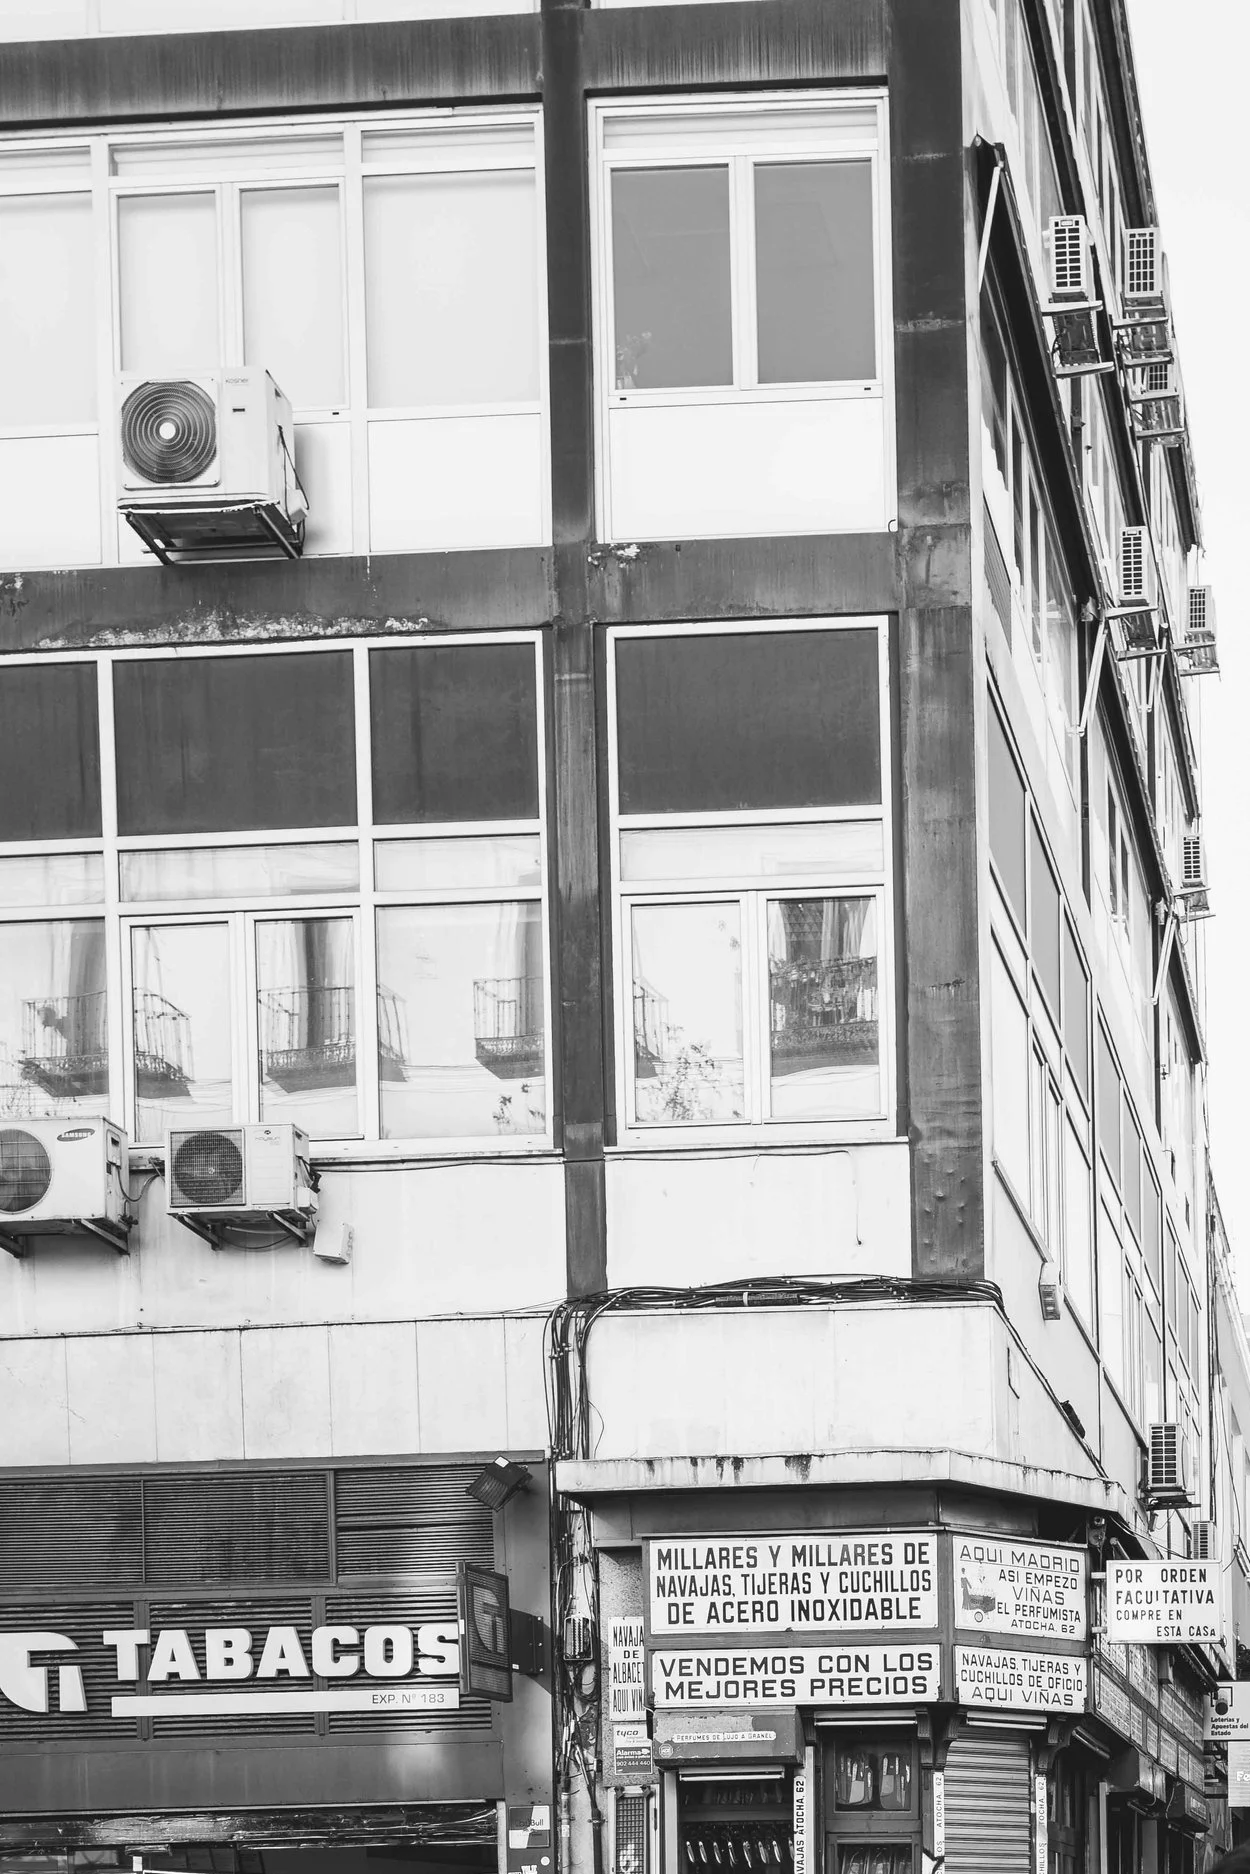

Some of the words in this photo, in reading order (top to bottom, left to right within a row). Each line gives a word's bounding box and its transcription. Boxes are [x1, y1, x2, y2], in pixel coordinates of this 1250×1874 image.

[658, 1546, 758, 1570] MILLARES
[768, 1545, 781, 1568] Y
[792, 1543, 893, 1567] MILLARES
[904, 1542, 930, 1565] DE
[960, 1545, 1003, 1564] AQUI
[1011, 1550, 1080, 1573] MADRID
[656, 1574, 735, 1598] NAVAJAS,
[741, 1572, 812, 1595] TIJERAS
[820, 1571, 830, 1594] Y
[839, 1569, 931, 1593] CUCHILLOS
[999, 1569, 1019, 1583] ASI
[1025, 1572, 1078, 1590] EMPEZO
[1115, 1568, 1143, 1583] POR
[1160, 1568, 1207, 1583] ORDEN
[1012, 1586, 1065, 1606] VIÑAS
[668, 1602, 695, 1625] DE
[706, 1600, 779, 1624] ACERO
[791, 1597, 921, 1622] INOXIDABLE
[997, 1602, 1010, 1615] EL
[1014, 1603, 1081, 1623] PERFUMISTA
[1116, 1609, 1162, 1621] COMPRE
[1168, 1609, 1182, 1620] EN
[613, 1625, 645, 1647] NAVAJA
[1061, 1624, 1076, 1634] 62
[1156, 1625, 1182, 1637] ESTA
[103, 1623, 461, 1682] TABACOS
[623, 1650, 639, 1659] DE
[659, 1656, 805, 1677] VENDEMOS
[818, 1654, 870, 1674] CON
[883, 1652, 933, 1673] LOS
[1022, 1658, 1069, 1675] TIJERAS
[1074, 1663, 1081, 1676] Y
[665, 1678, 796, 1700] MEJORES
[810, 1676, 928, 1697] PRECIOS
[960, 1669, 1023, 1686] CUCHILLOS
[1028, 1675, 1043, 1688] DE
[1047, 1676, 1083, 1692] OFICIO
[372, 1694, 398, 1704] EXP.
[421, 1693, 445, 1703] 183
[612, 1689, 629, 1714] AQUI
[631, 1687, 645, 1712] VIÑ
[972, 1686, 1013, 1703] AQUI
[1022, 1688, 1074, 1706] VIÑAS
[796, 1780, 805, 1793] 62
[936, 1776, 943, 1786] 62
[1038, 1781, 1045, 1791] 62
[530, 1818, 544, 1827] Bull
